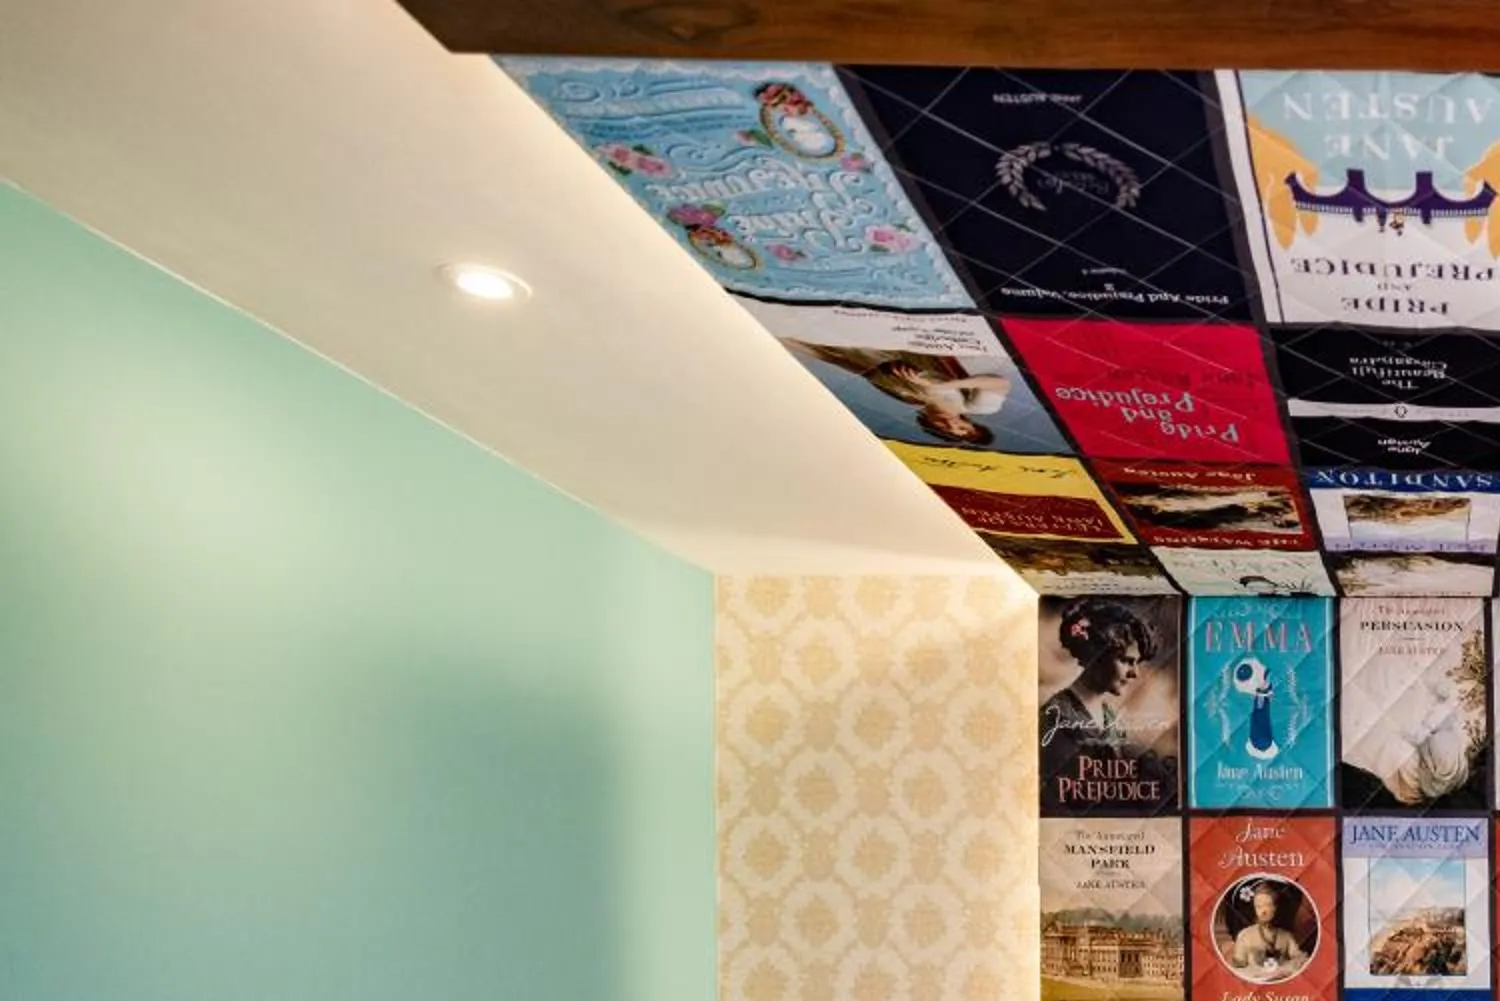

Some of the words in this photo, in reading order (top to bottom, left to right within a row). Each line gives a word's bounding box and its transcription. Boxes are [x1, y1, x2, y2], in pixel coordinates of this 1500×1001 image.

[1282, 92, 1493, 124] AUSTEN
[1326, 134, 1453, 160] JANE
[1290, 259, 1493, 281] PREJUDICE
[1186, 295, 1228, 304] Pride
[1341, 298, 1448, 315] PRIDE
[1055, 386, 1195, 413] Prejudice
[1120, 406, 1172, 423] and
[1160, 420, 1241, 443] Pride
[1315, 469, 1493, 488] SANDITON
[1205, 621, 1312, 652] EMMA
[1361, 621, 1463, 631] PERSUASION
[1042, 704, 1098, 747] Jane
[1079, 755, 1138, 780] PRIDE
[1217, 761, 1248, 779] Jane
[1254, 763, 1303, 780] Austen
[1056, 777, 1160, 802] PREJUDICE
[1236, 818, 1286, 843] Jane
[1350, 825, 1398, 844] JANE
[1403, 825, 1480, 842] AUSTEN
[1064, 845, 1155, 855] MANSFIELD
[1219, 846, 1305, 869] Austen
[1091, 860, 1130, 869] PARK
